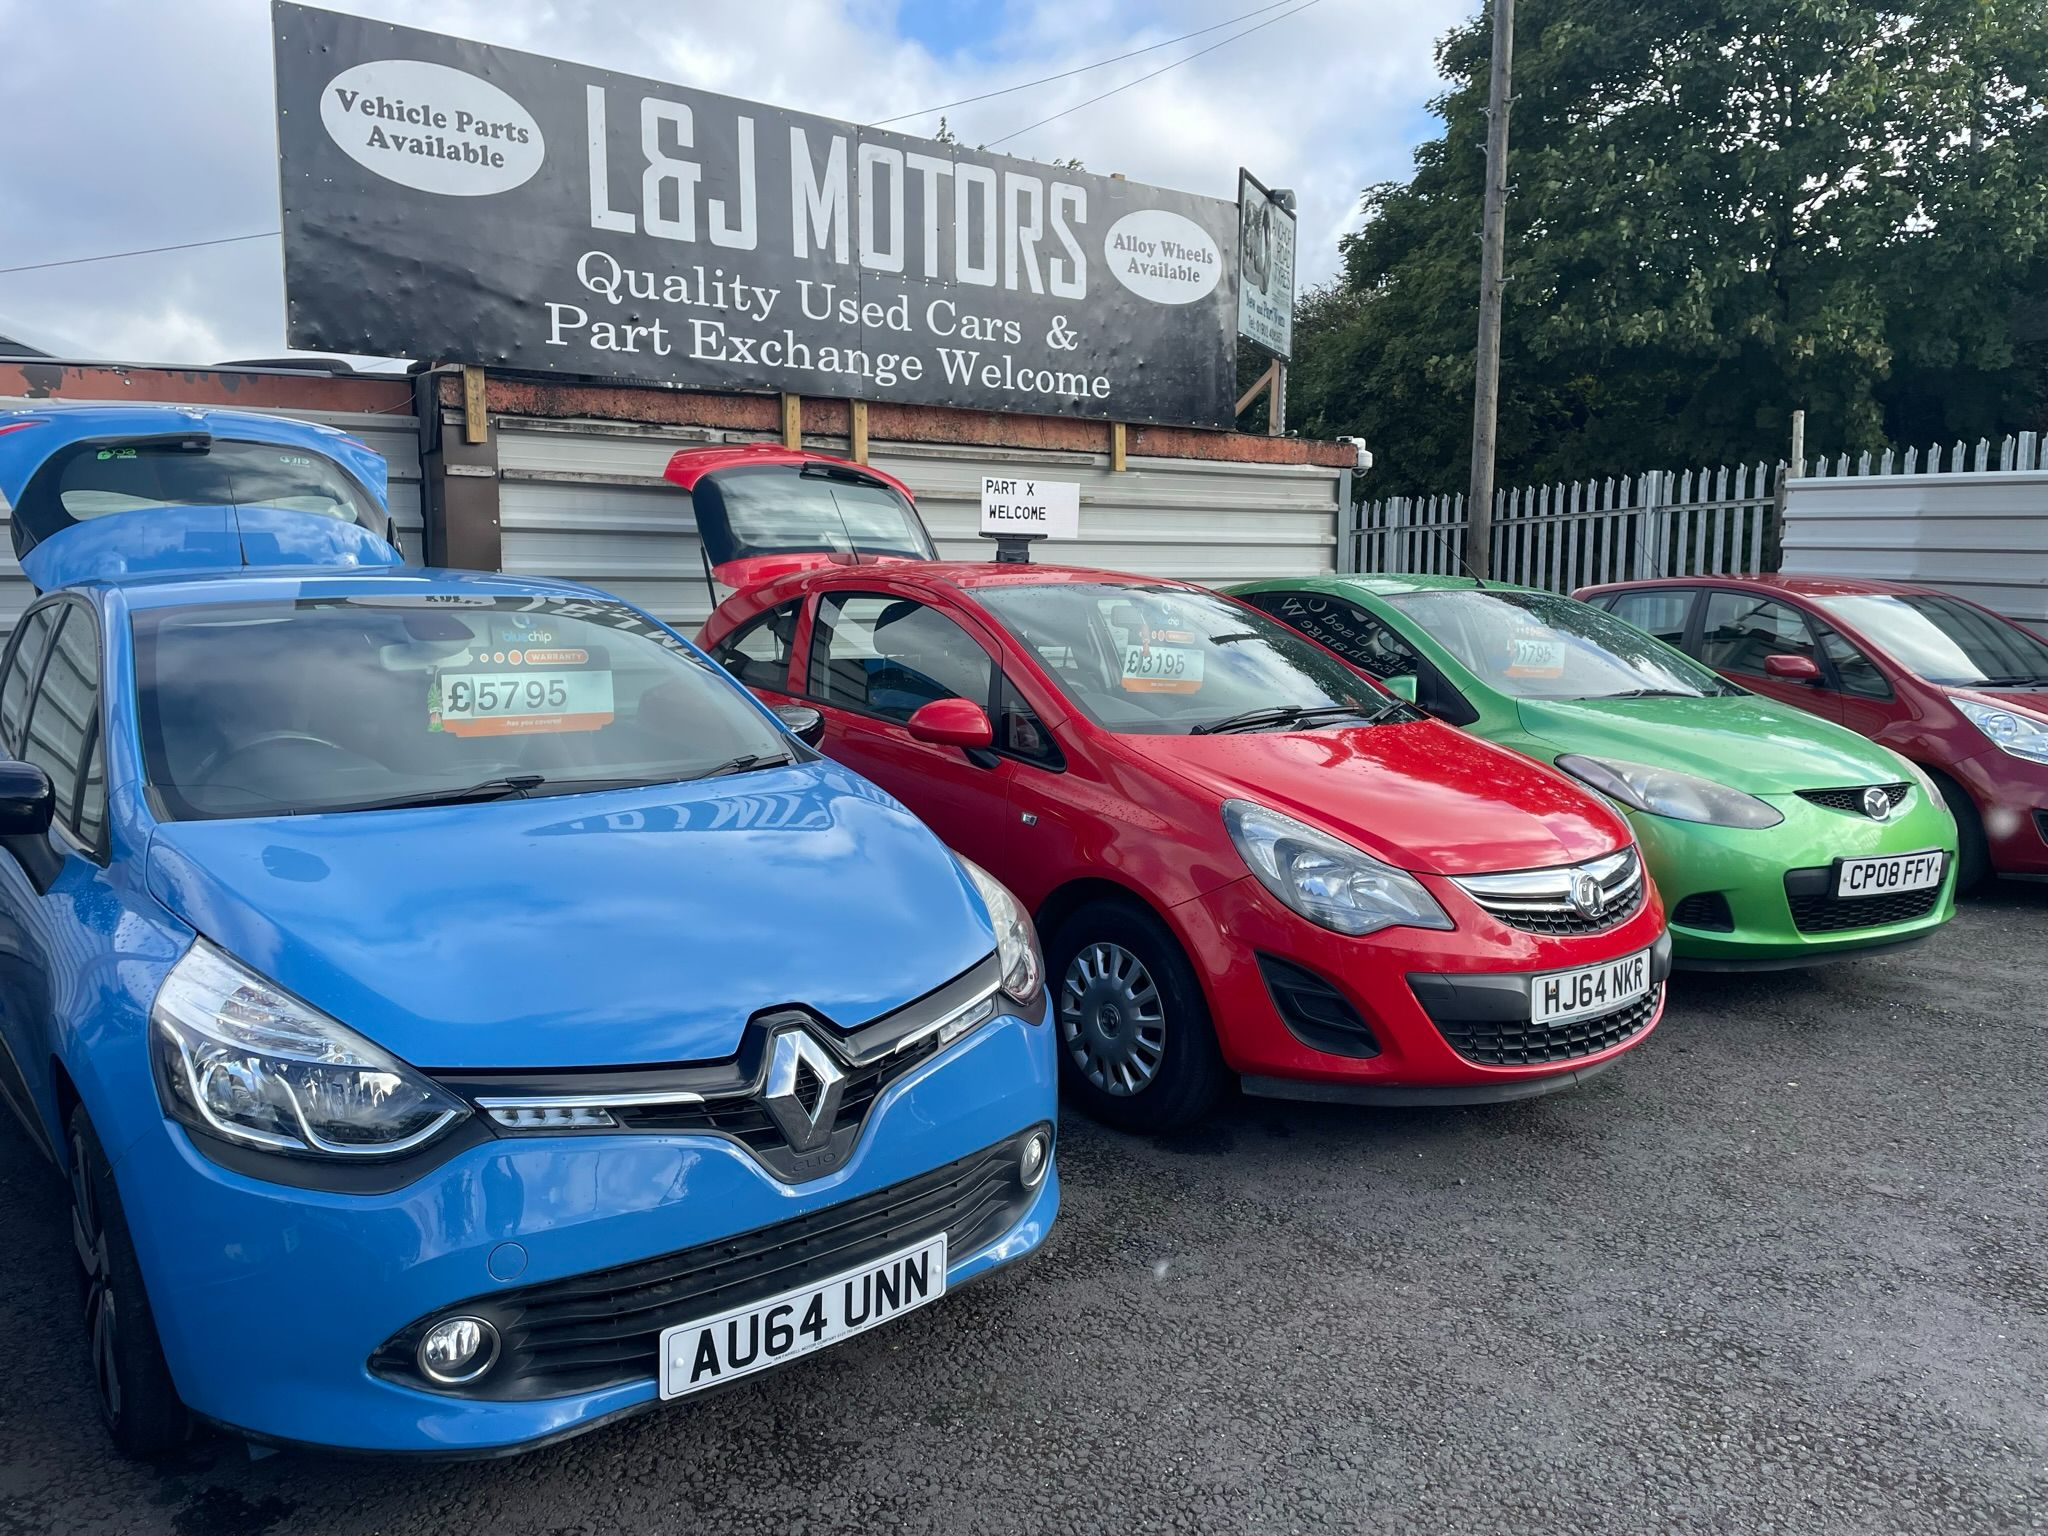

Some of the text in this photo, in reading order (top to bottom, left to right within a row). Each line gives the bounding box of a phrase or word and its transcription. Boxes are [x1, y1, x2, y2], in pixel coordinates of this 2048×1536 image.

[335, 88, 530, 144] Vehicle Parts
[366, 126, 505, 168] Available
[586, 84, 1088, 299] L&J MOTORS
[1113, 232, 1214, 266] Alloy Wheels
[1127, 256, 1201, 283] Available
[576, 250, 1079, 351] Quality Used Cars &
[545, 301, 1111, 398] Part Exchange Welcome
[986, 480, 1035, 496] PART X
[989, 504, 1046, 520] WELCOME
[531, 652, 581, 661] WARRANTY
[448, 679, 567, 712] £5795
[1850, 857, 1935, 889] CP08 FFY
[1545, 957, 1643, 1015] HJ64 NKR
[792, 1154, 836, 1173] CLIO
[690, 1250, 929, 1383] AU64 UNN
